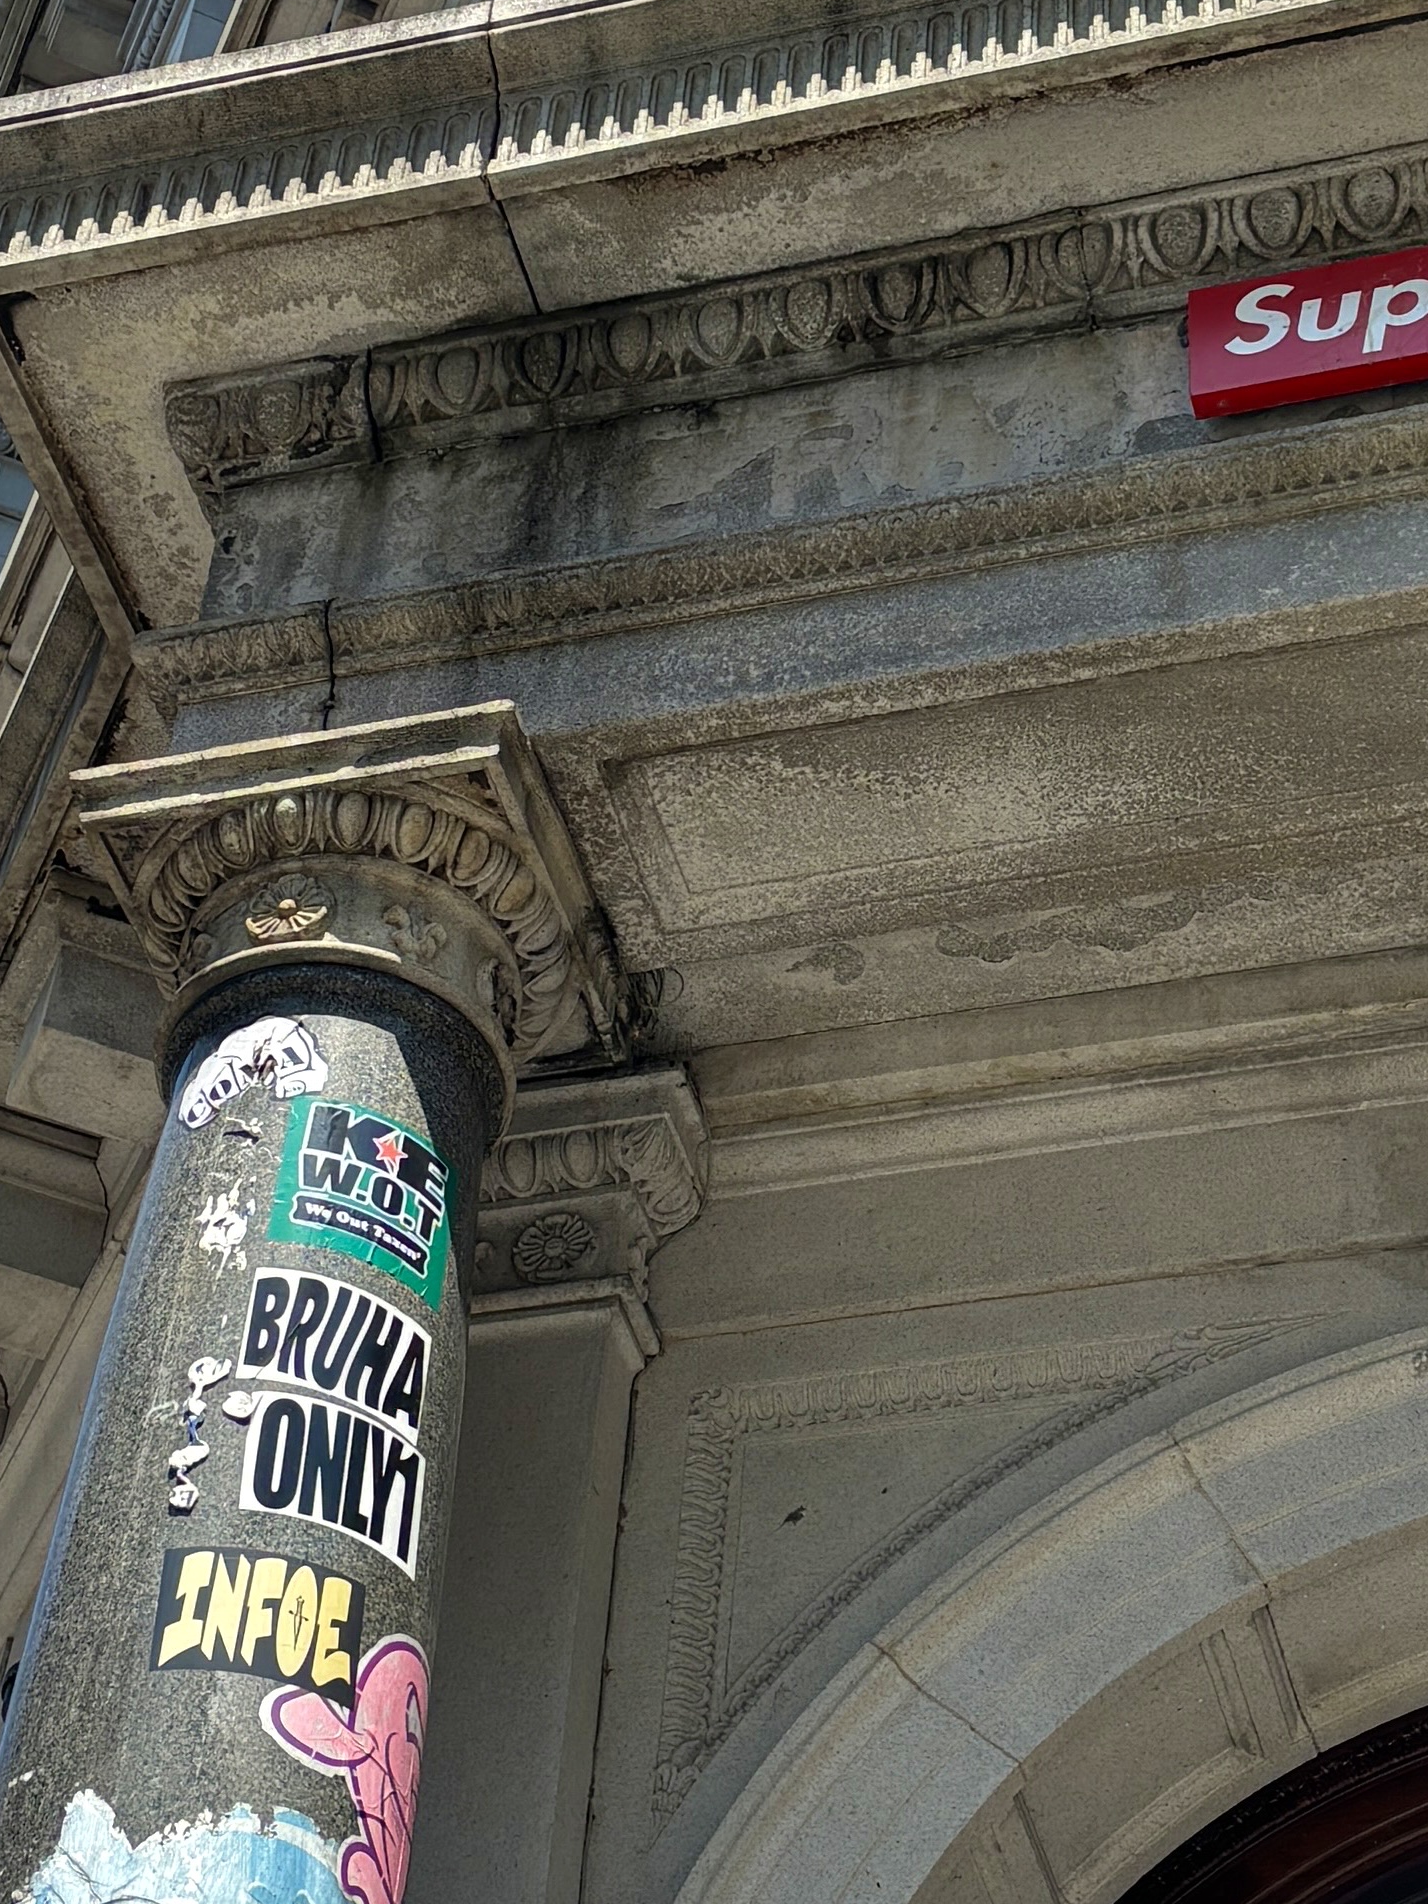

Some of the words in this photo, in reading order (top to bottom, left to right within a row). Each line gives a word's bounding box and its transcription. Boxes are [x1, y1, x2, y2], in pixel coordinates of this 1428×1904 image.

[305, 1201, 332, 1220] We
[335, 1209, 369, 1232] Out
[243, 1276, 427, 1430] BRUHA
[158, 1551, 353, 1688] INFOE
